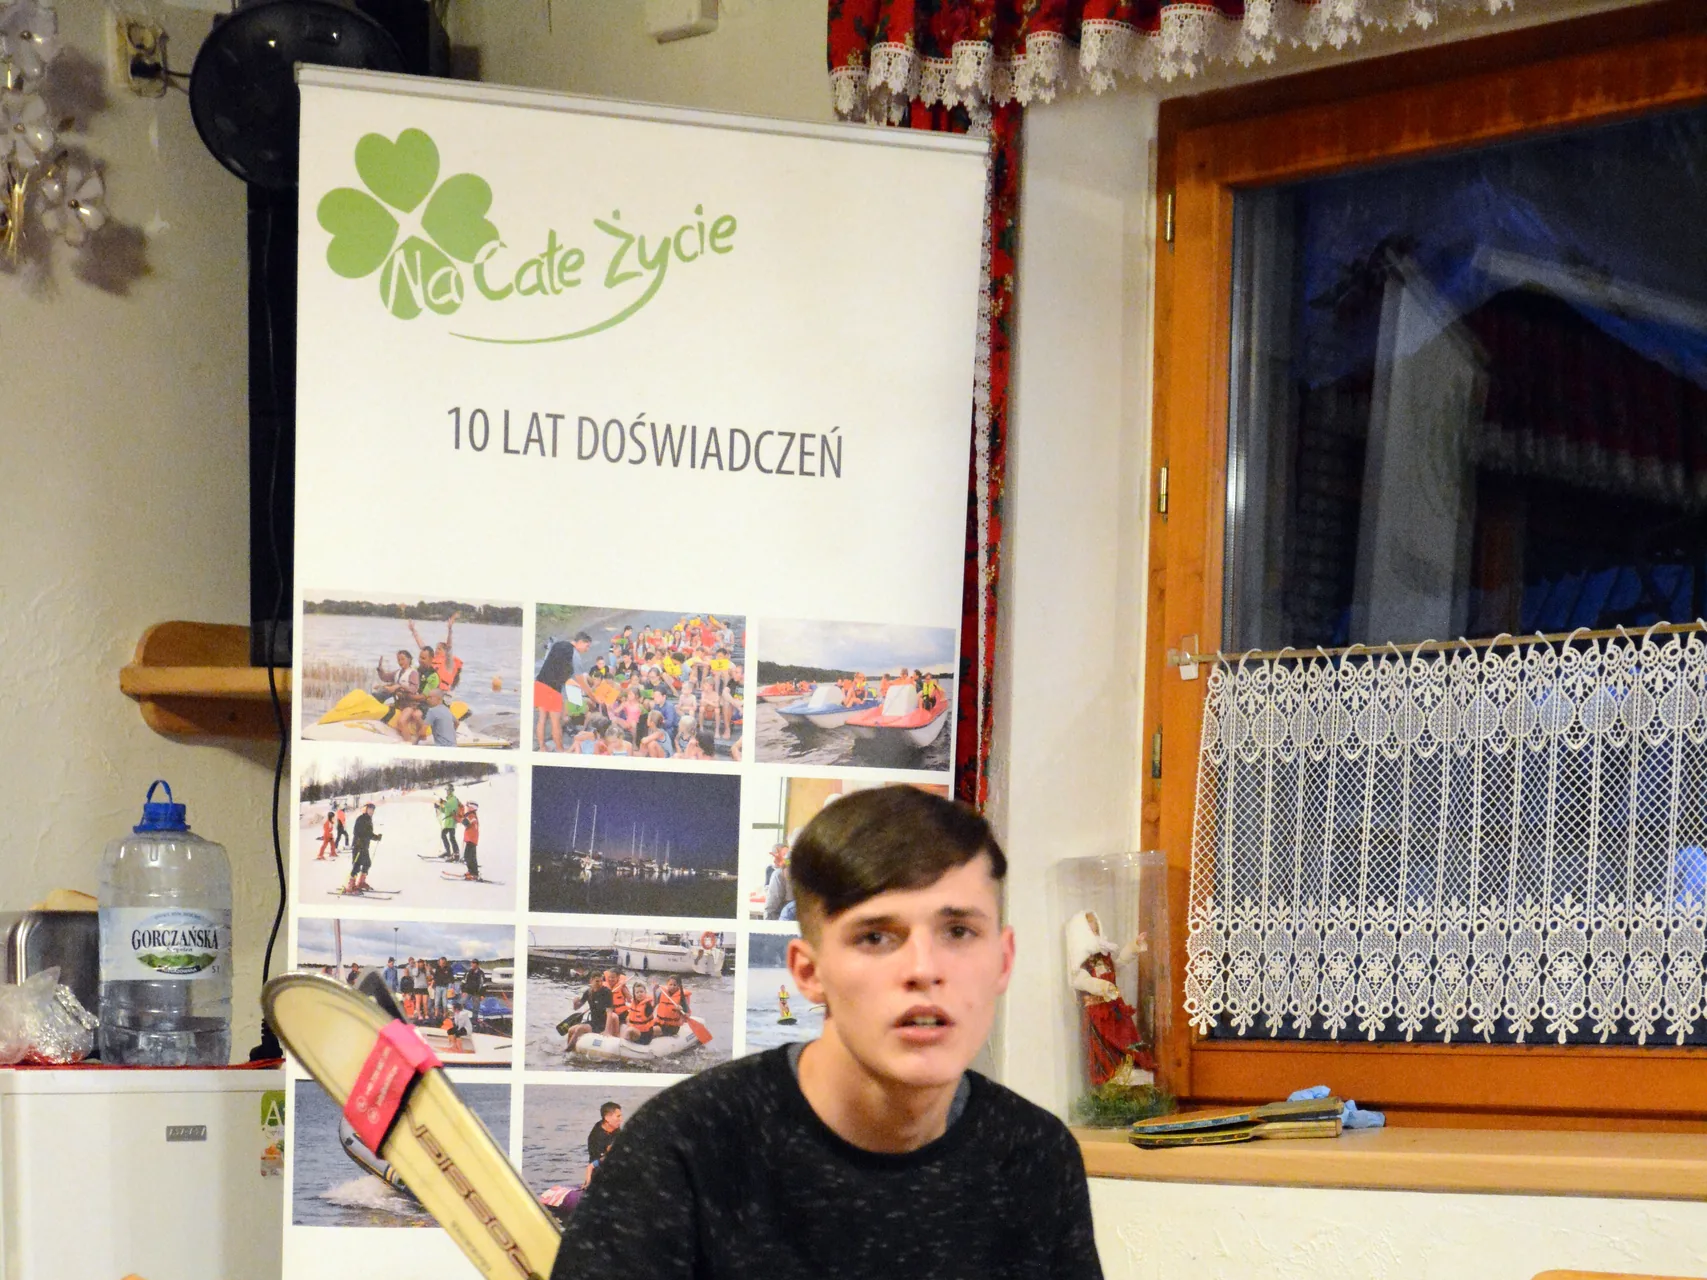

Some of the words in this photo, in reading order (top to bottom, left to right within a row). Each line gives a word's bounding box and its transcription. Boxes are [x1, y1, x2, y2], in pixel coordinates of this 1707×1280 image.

[387, 247, 464, 312] Na
[593, 203, 738, 302] Życie
[446, 406, 490, 453] 10
[503, 408, 565, 458] LAT
[577, 411, 843, 479] DOŚWIADCZEŃ
[131, 926, 219, 950] GORCZAŃSKA
